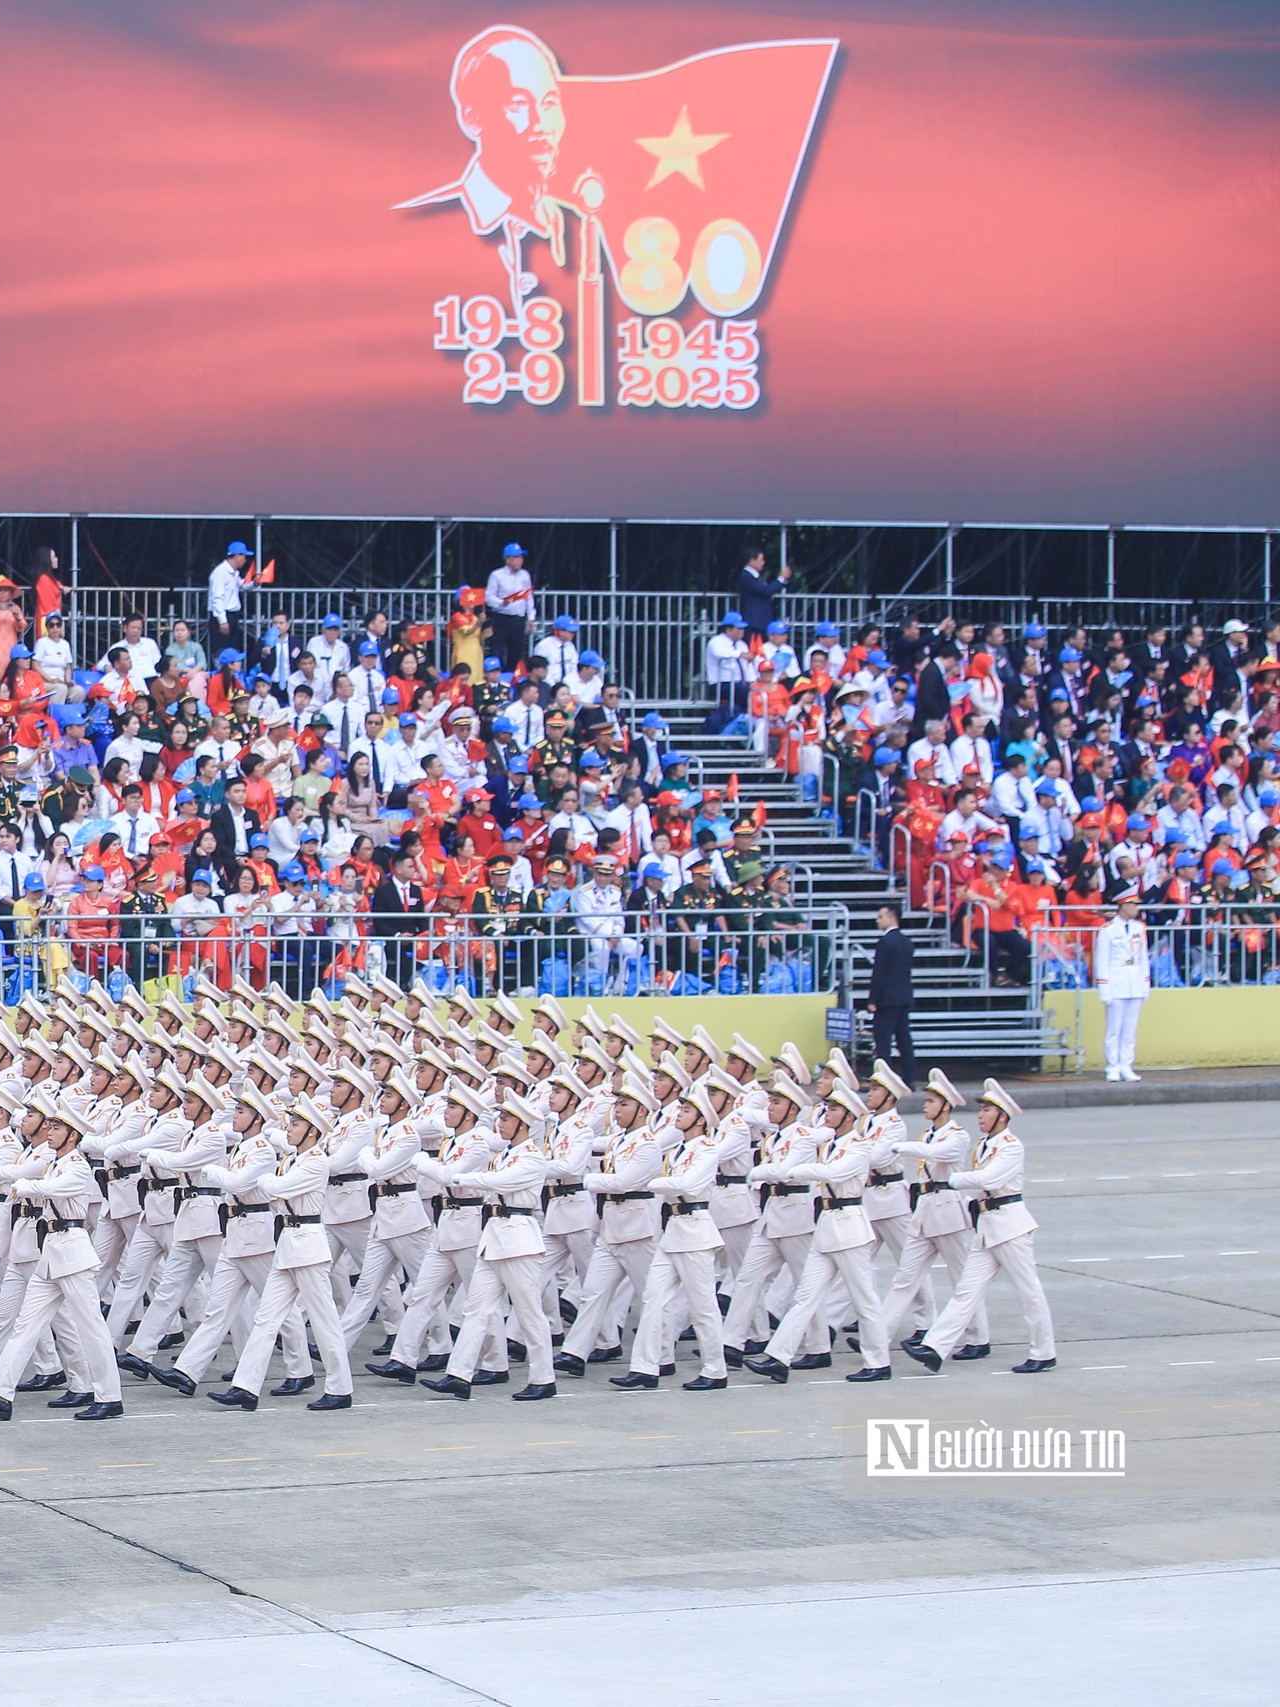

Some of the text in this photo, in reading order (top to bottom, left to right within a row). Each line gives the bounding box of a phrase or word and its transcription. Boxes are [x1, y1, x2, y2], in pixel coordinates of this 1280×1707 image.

[621, 217, 762, 315] 80
[436, 297, 562, 349] 19-8
[620, 320, 758, 362] 1945
[465, 351, 563, 402] 2-9
[620, 364, 758, 405] 2025
